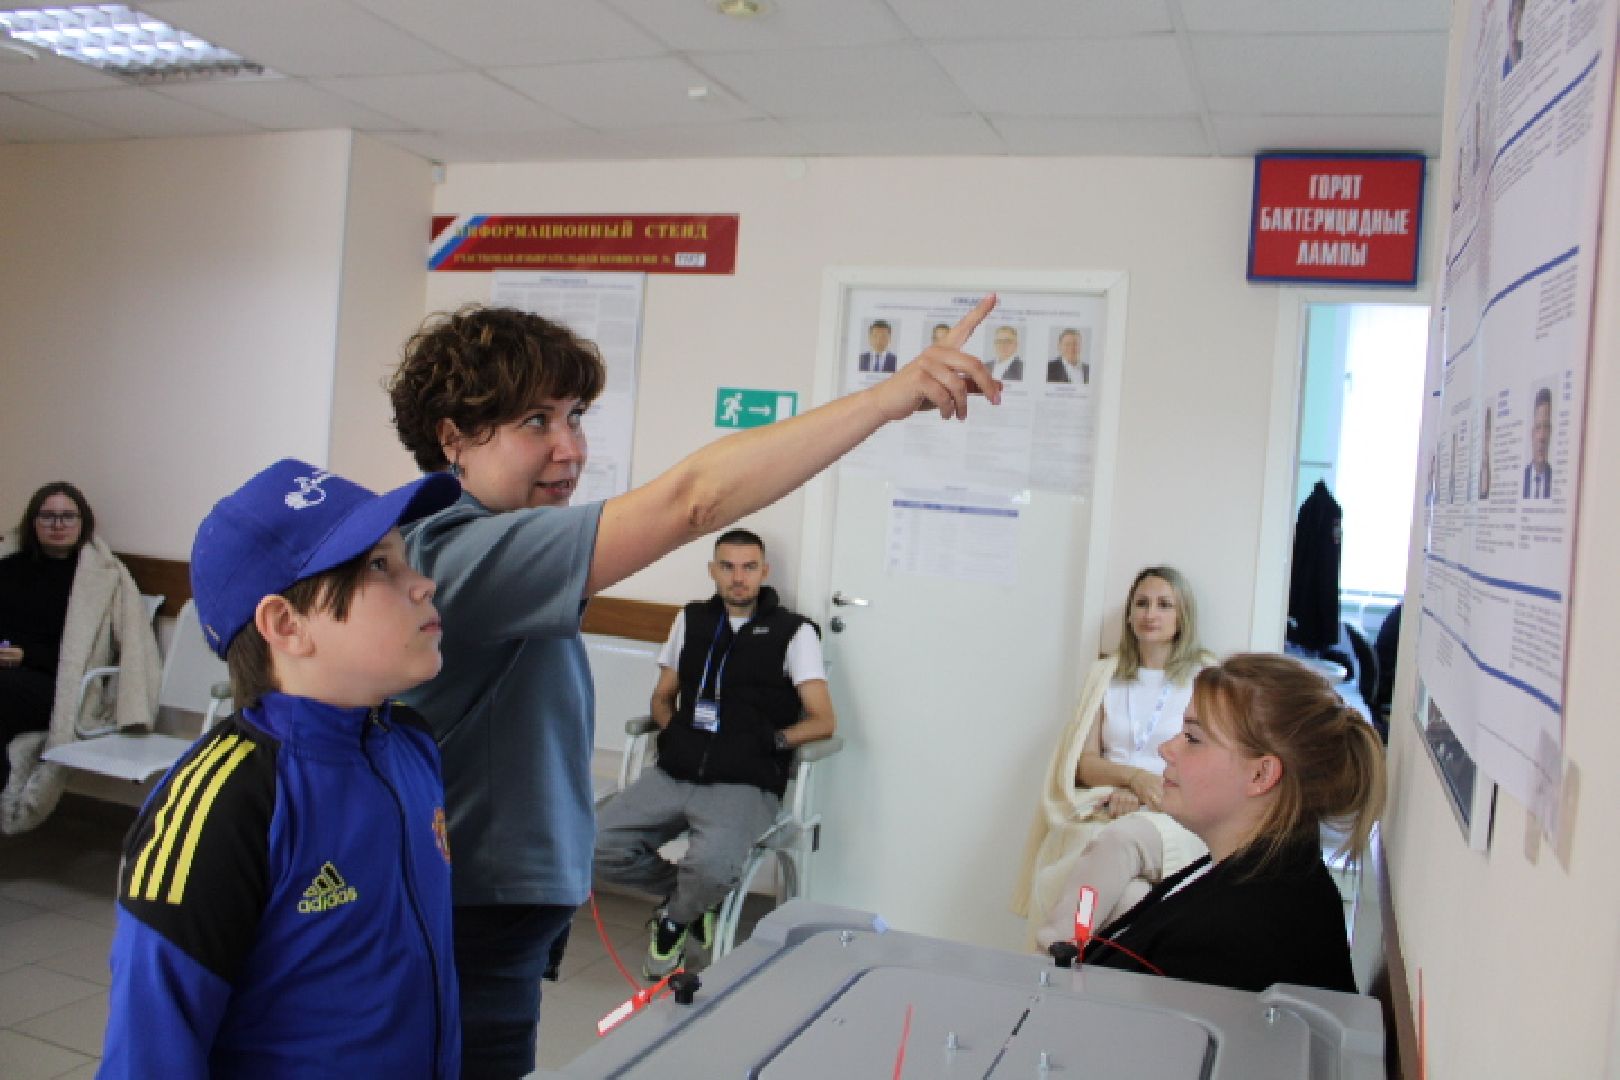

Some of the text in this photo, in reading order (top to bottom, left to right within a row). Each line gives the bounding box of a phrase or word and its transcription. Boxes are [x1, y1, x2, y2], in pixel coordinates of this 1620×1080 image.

[1309, 174, 1363, 200] ГОРЯТ
[644, 222, 708, 240] СТЕНД
[1260, 206, 1409, 237] БАКТЕРИЦИДНЫЕ
[1296, 240, 1368, 267] ЛАМПЫ
[297, 887, 357, 913] adidas
